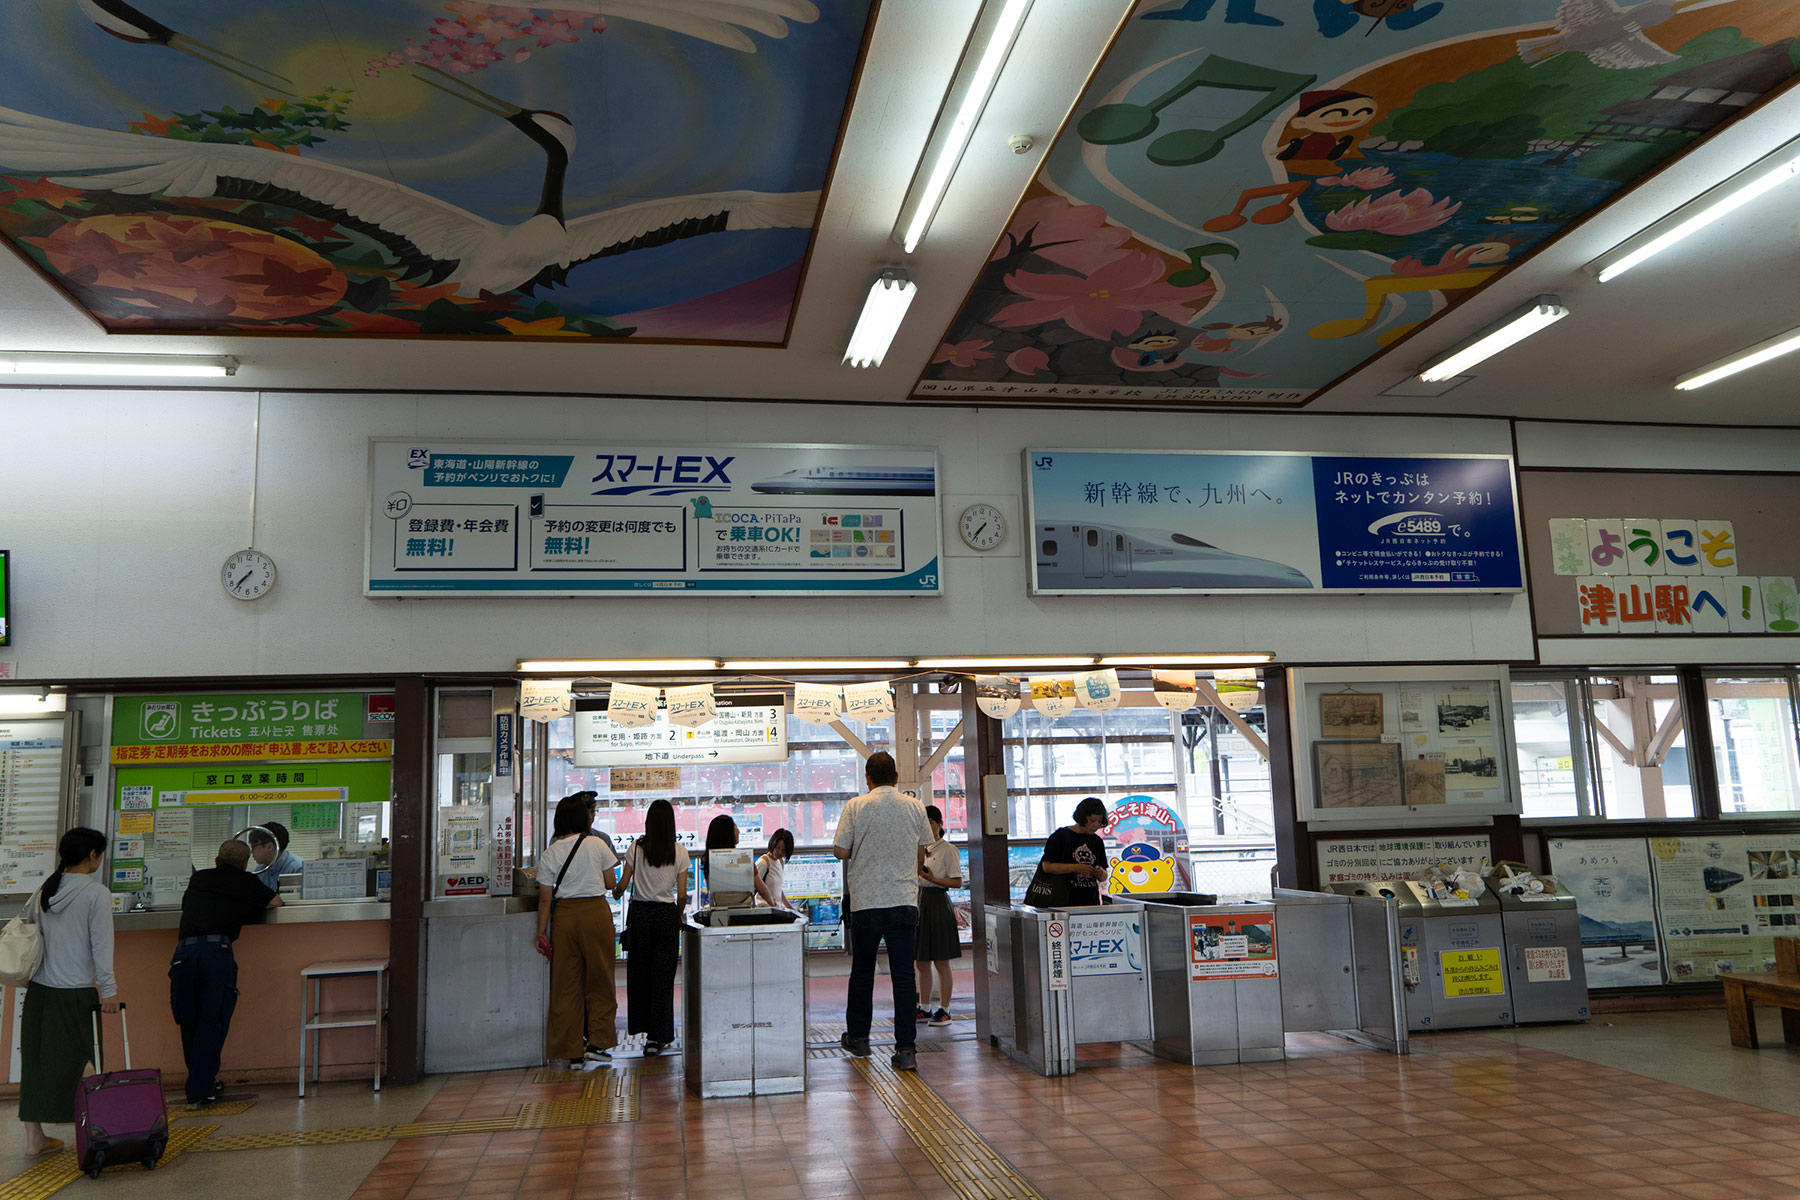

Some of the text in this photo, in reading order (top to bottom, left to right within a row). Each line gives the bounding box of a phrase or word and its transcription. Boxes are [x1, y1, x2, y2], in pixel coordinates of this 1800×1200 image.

[410, 449, 428, 459] EX
[433, 458, 540, 471] 東海道・山陽新幹線の
[592, 454, 737, 485] スマートEX
[1035, 456, 1053, 468] JR
[434, 472, 556, 484] 予約がベンリでおトクに!
[1333, 471, 1431, 487] JRのきっぷは
[1083, 480, 1284, 510] 新幹線で、九州へ。
[1335, 490, 1493, 506] ネットでカンタン予約!
[408, 518, 510, 534] 登録費・年会費
[543, 519, 678, 535] 予約の変更は何度でも
[1397, 519, 1442, 534] e5489
[405, 537, 454, 558] 無料!
[543, 536, 591, 556] 無料!
[1591, 528, 1736, 568] ようこそ
[919, 574, 937, 585] JR
[1579, 583, 1752, 626] 津山駅へ!
[191, 698, 340, 724] きっぷうりば
[769, 708, 778, 719] 3
[190, 725, 242, 740] Tickets
[669, 730, 677, 741] 2
[769, 726, 779, 738] 4
[645, 751, 670, 761] 地下道
[206, 772, 305, 786] 窓口営業時間
[457, 876, 486, 886] AED
[1052, 940, 1064, 979] 終日禁煙
[1420, 1016, 1432, 1026] JR
[1498, 1011, 1510, 1020] JR
